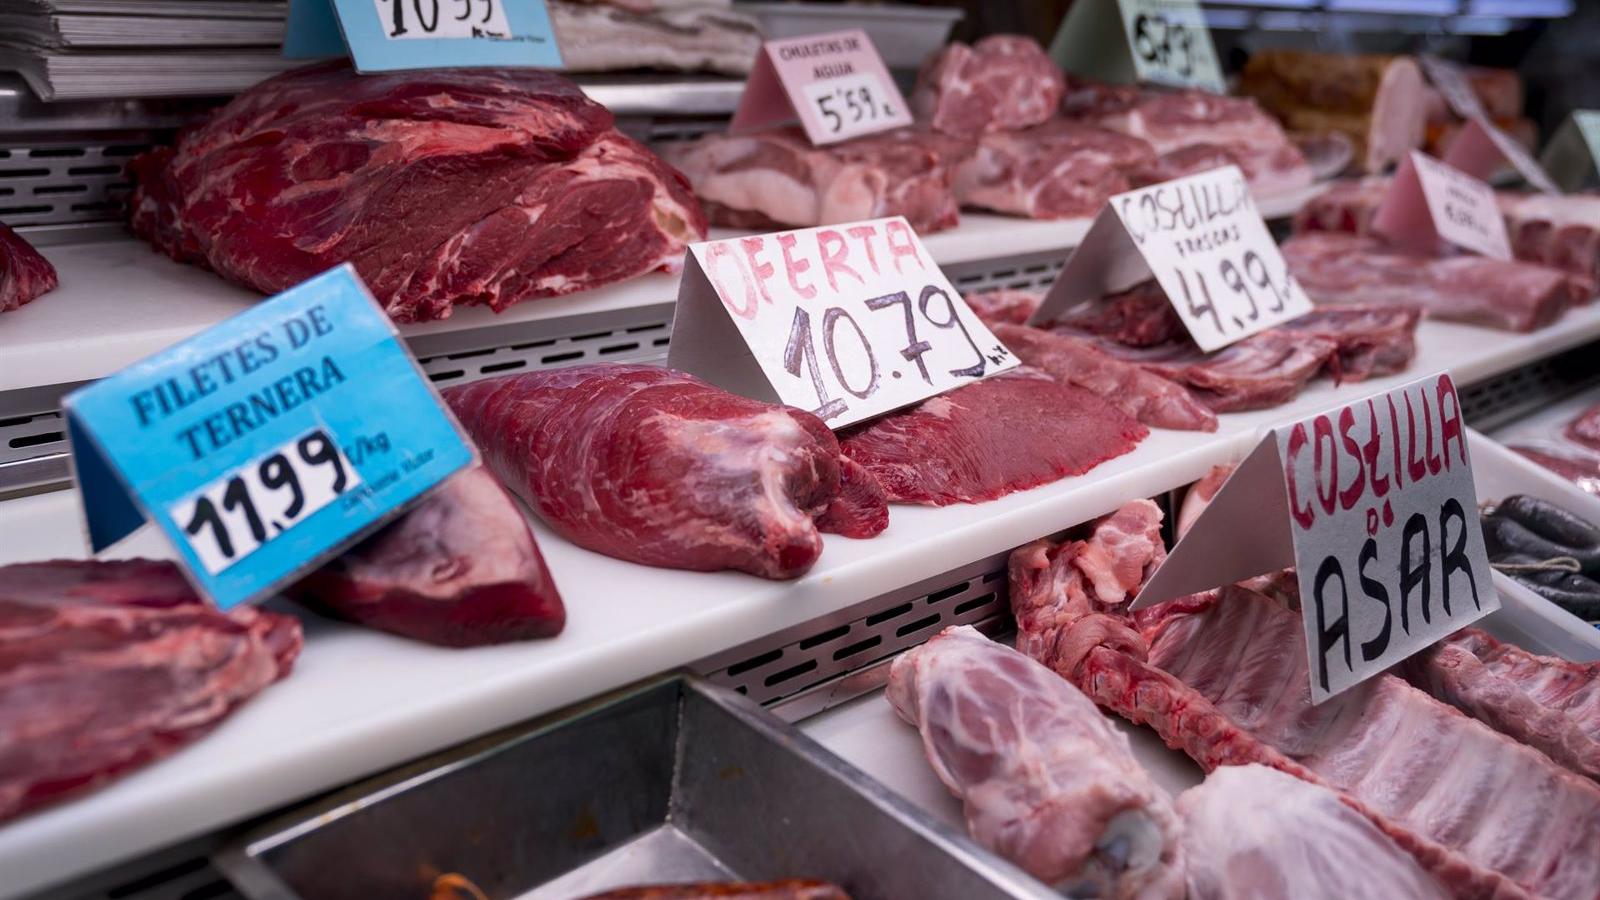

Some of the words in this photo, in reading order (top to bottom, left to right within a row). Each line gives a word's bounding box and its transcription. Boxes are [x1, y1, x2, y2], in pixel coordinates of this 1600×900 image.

[812, 63, 855, 80] AGUJA
[705, 221, 926, 321] OFERTA
[130, 332, 279, 427] FILETES
[283, 304, 334, 350] DE
[177, 355, 347, 461] TERNERA
[784, 285, 987, 422] 10.79
[1313, 498, 1481, 693] ASAR
